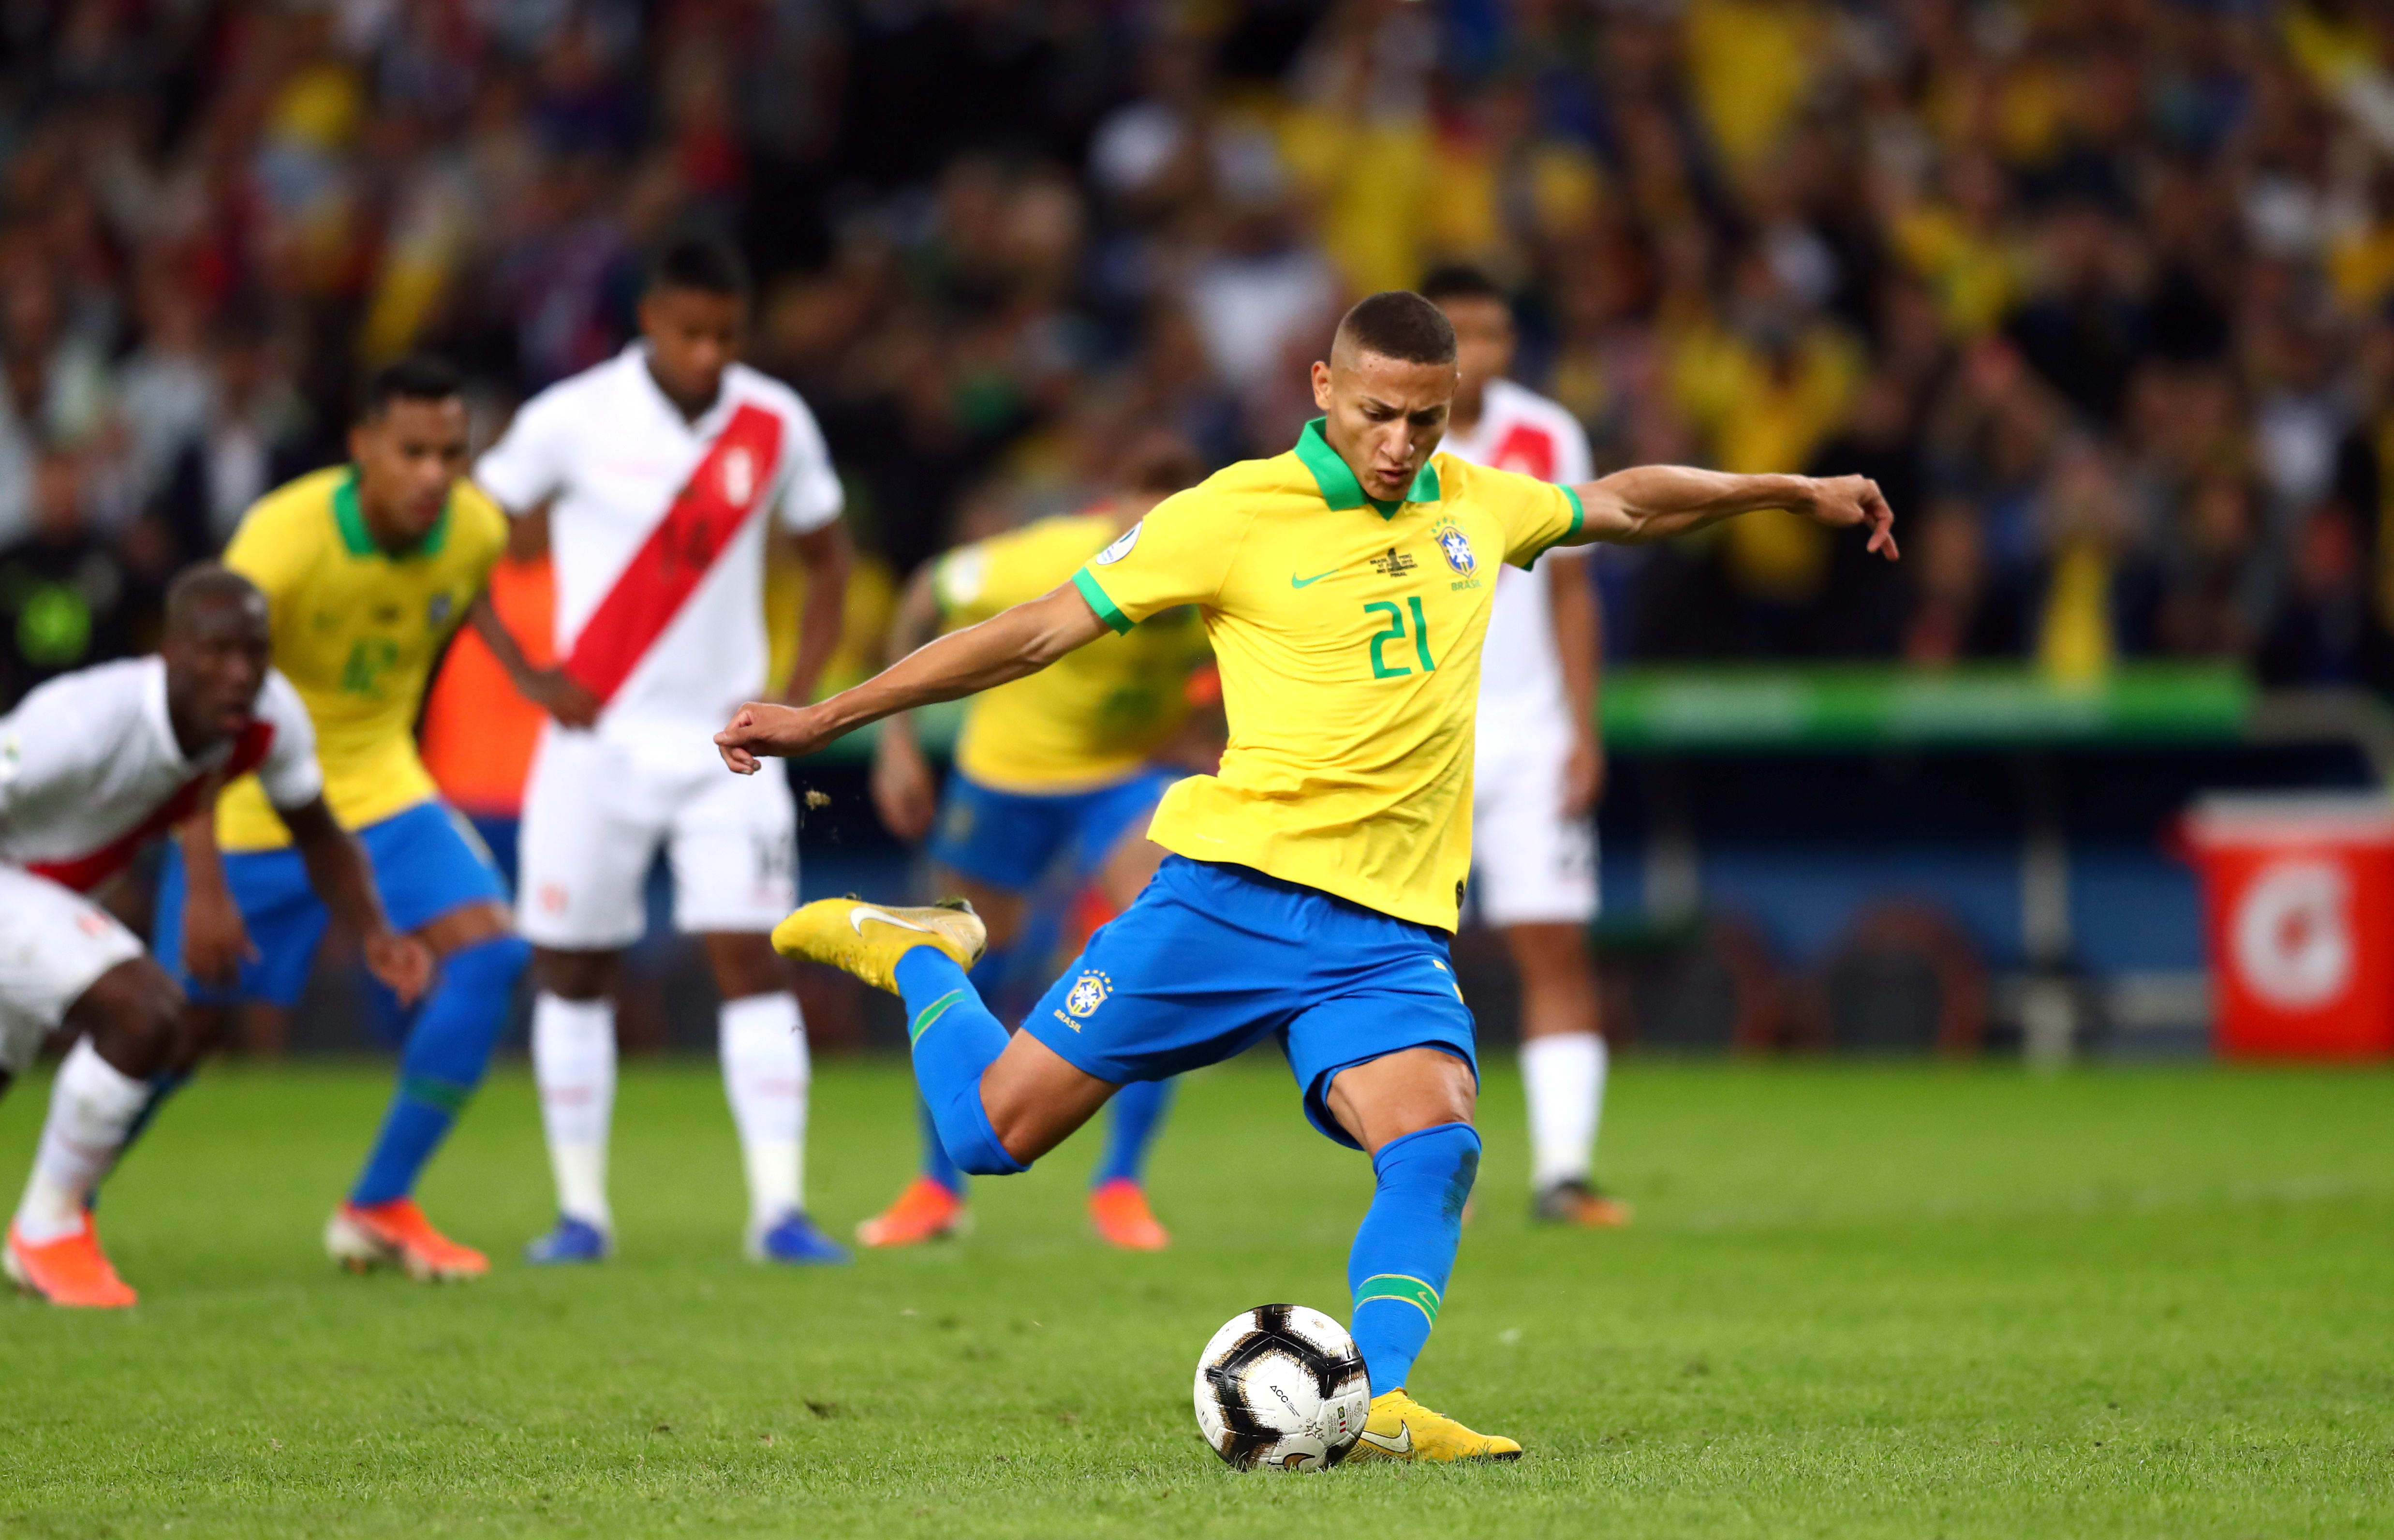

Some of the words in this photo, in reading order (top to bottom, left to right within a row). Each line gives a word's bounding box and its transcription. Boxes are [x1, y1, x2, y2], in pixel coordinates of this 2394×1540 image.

[1451, 579, 1482, 591] BRASIL
[1364, 596, 1435, 679] 21
[1053, 1009, 1082, 1033] BRASIL
